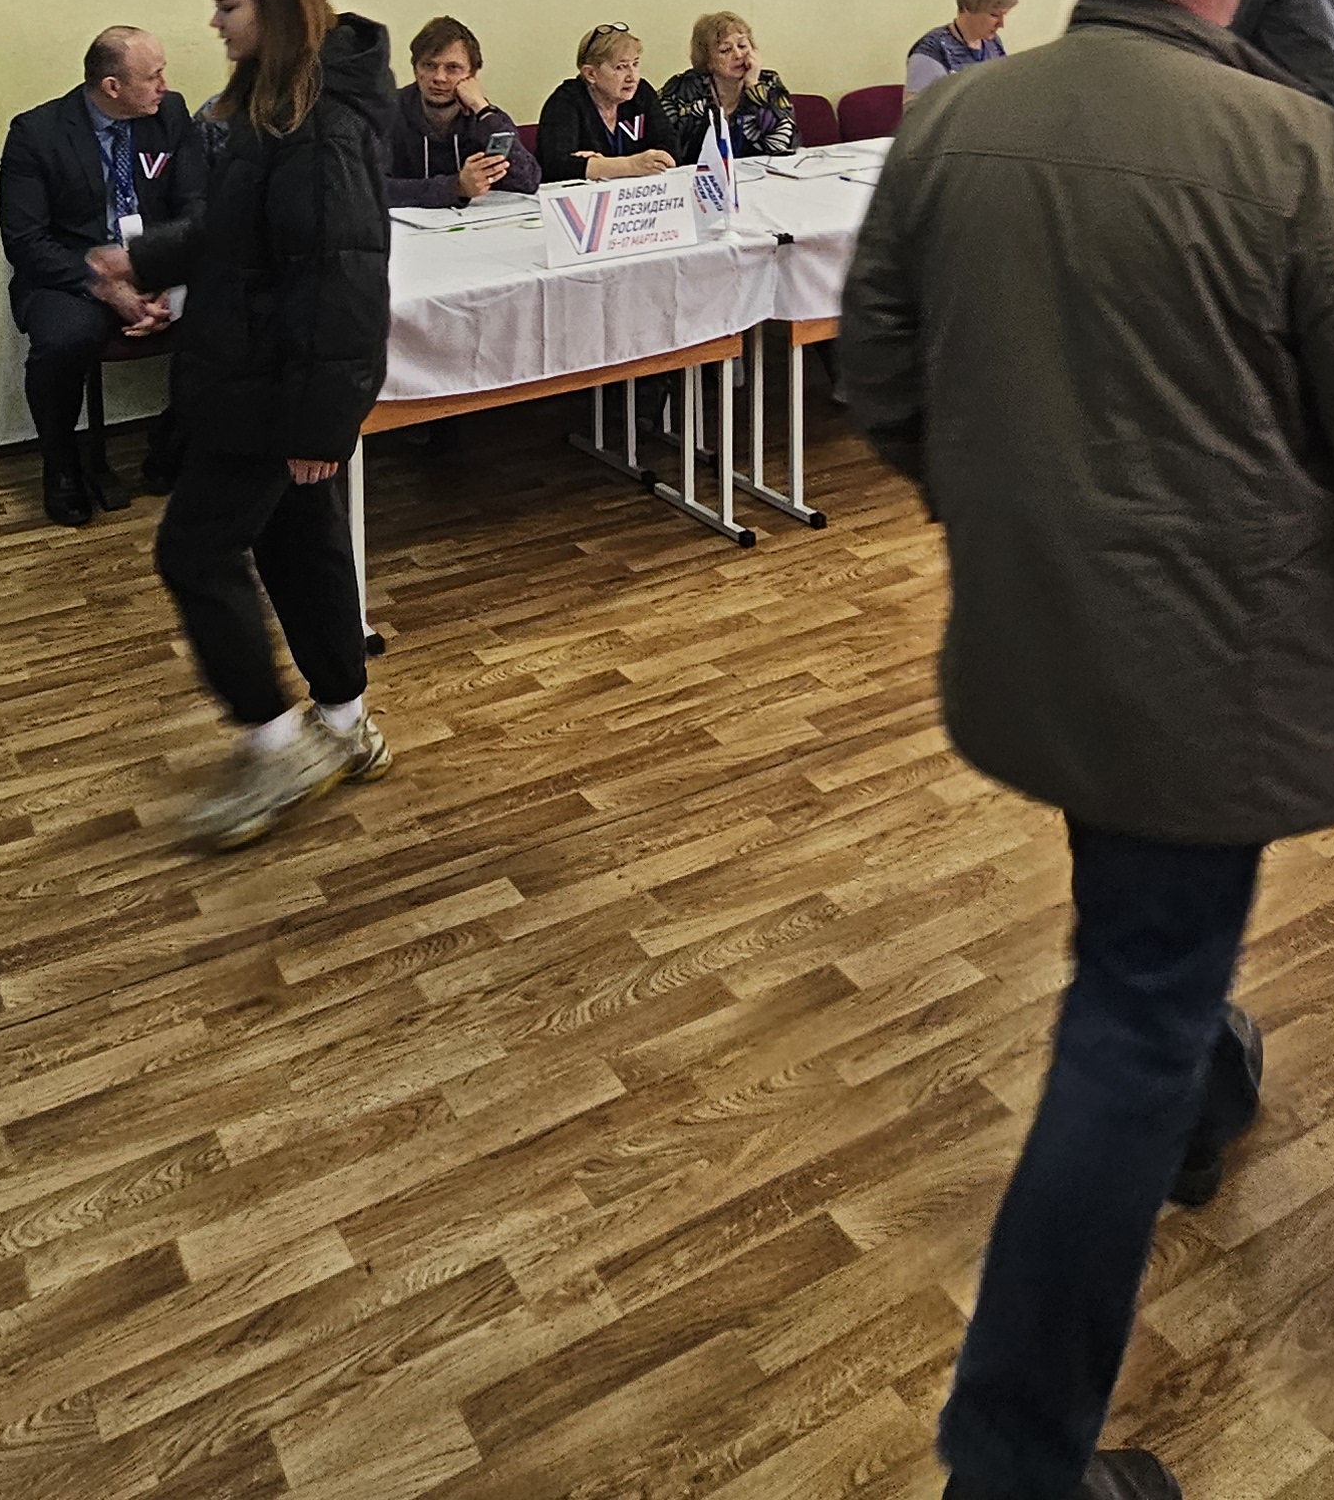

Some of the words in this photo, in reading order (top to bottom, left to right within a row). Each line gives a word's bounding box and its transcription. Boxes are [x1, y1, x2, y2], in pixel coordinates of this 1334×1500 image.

[618, 183, 667, 201] ВЫБОРЫ
[614, 197, 685, 218] ПРЕЗИДЕНТА
[610, 217, 657, 236] РОССИИ
[631, 232, 658, 247] МАРТА
